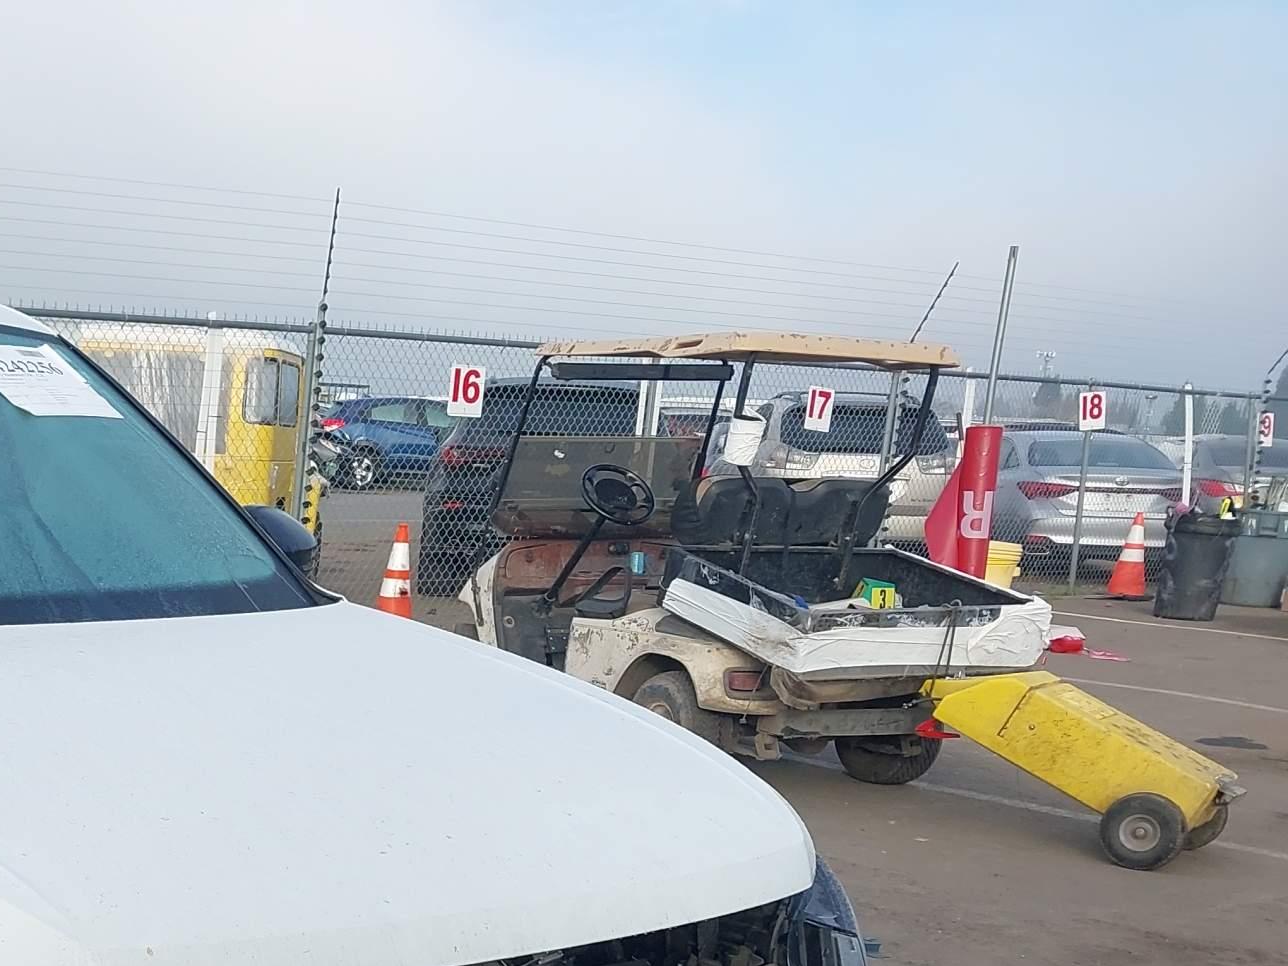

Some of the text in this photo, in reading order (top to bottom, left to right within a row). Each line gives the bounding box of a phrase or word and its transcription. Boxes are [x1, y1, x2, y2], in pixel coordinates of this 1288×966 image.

[452, 368, 481, 404] 16
[808, 389, 832, 420] 17
[1082, 394, 1103, 420] 18
[879, 589, 887, 609] 3
